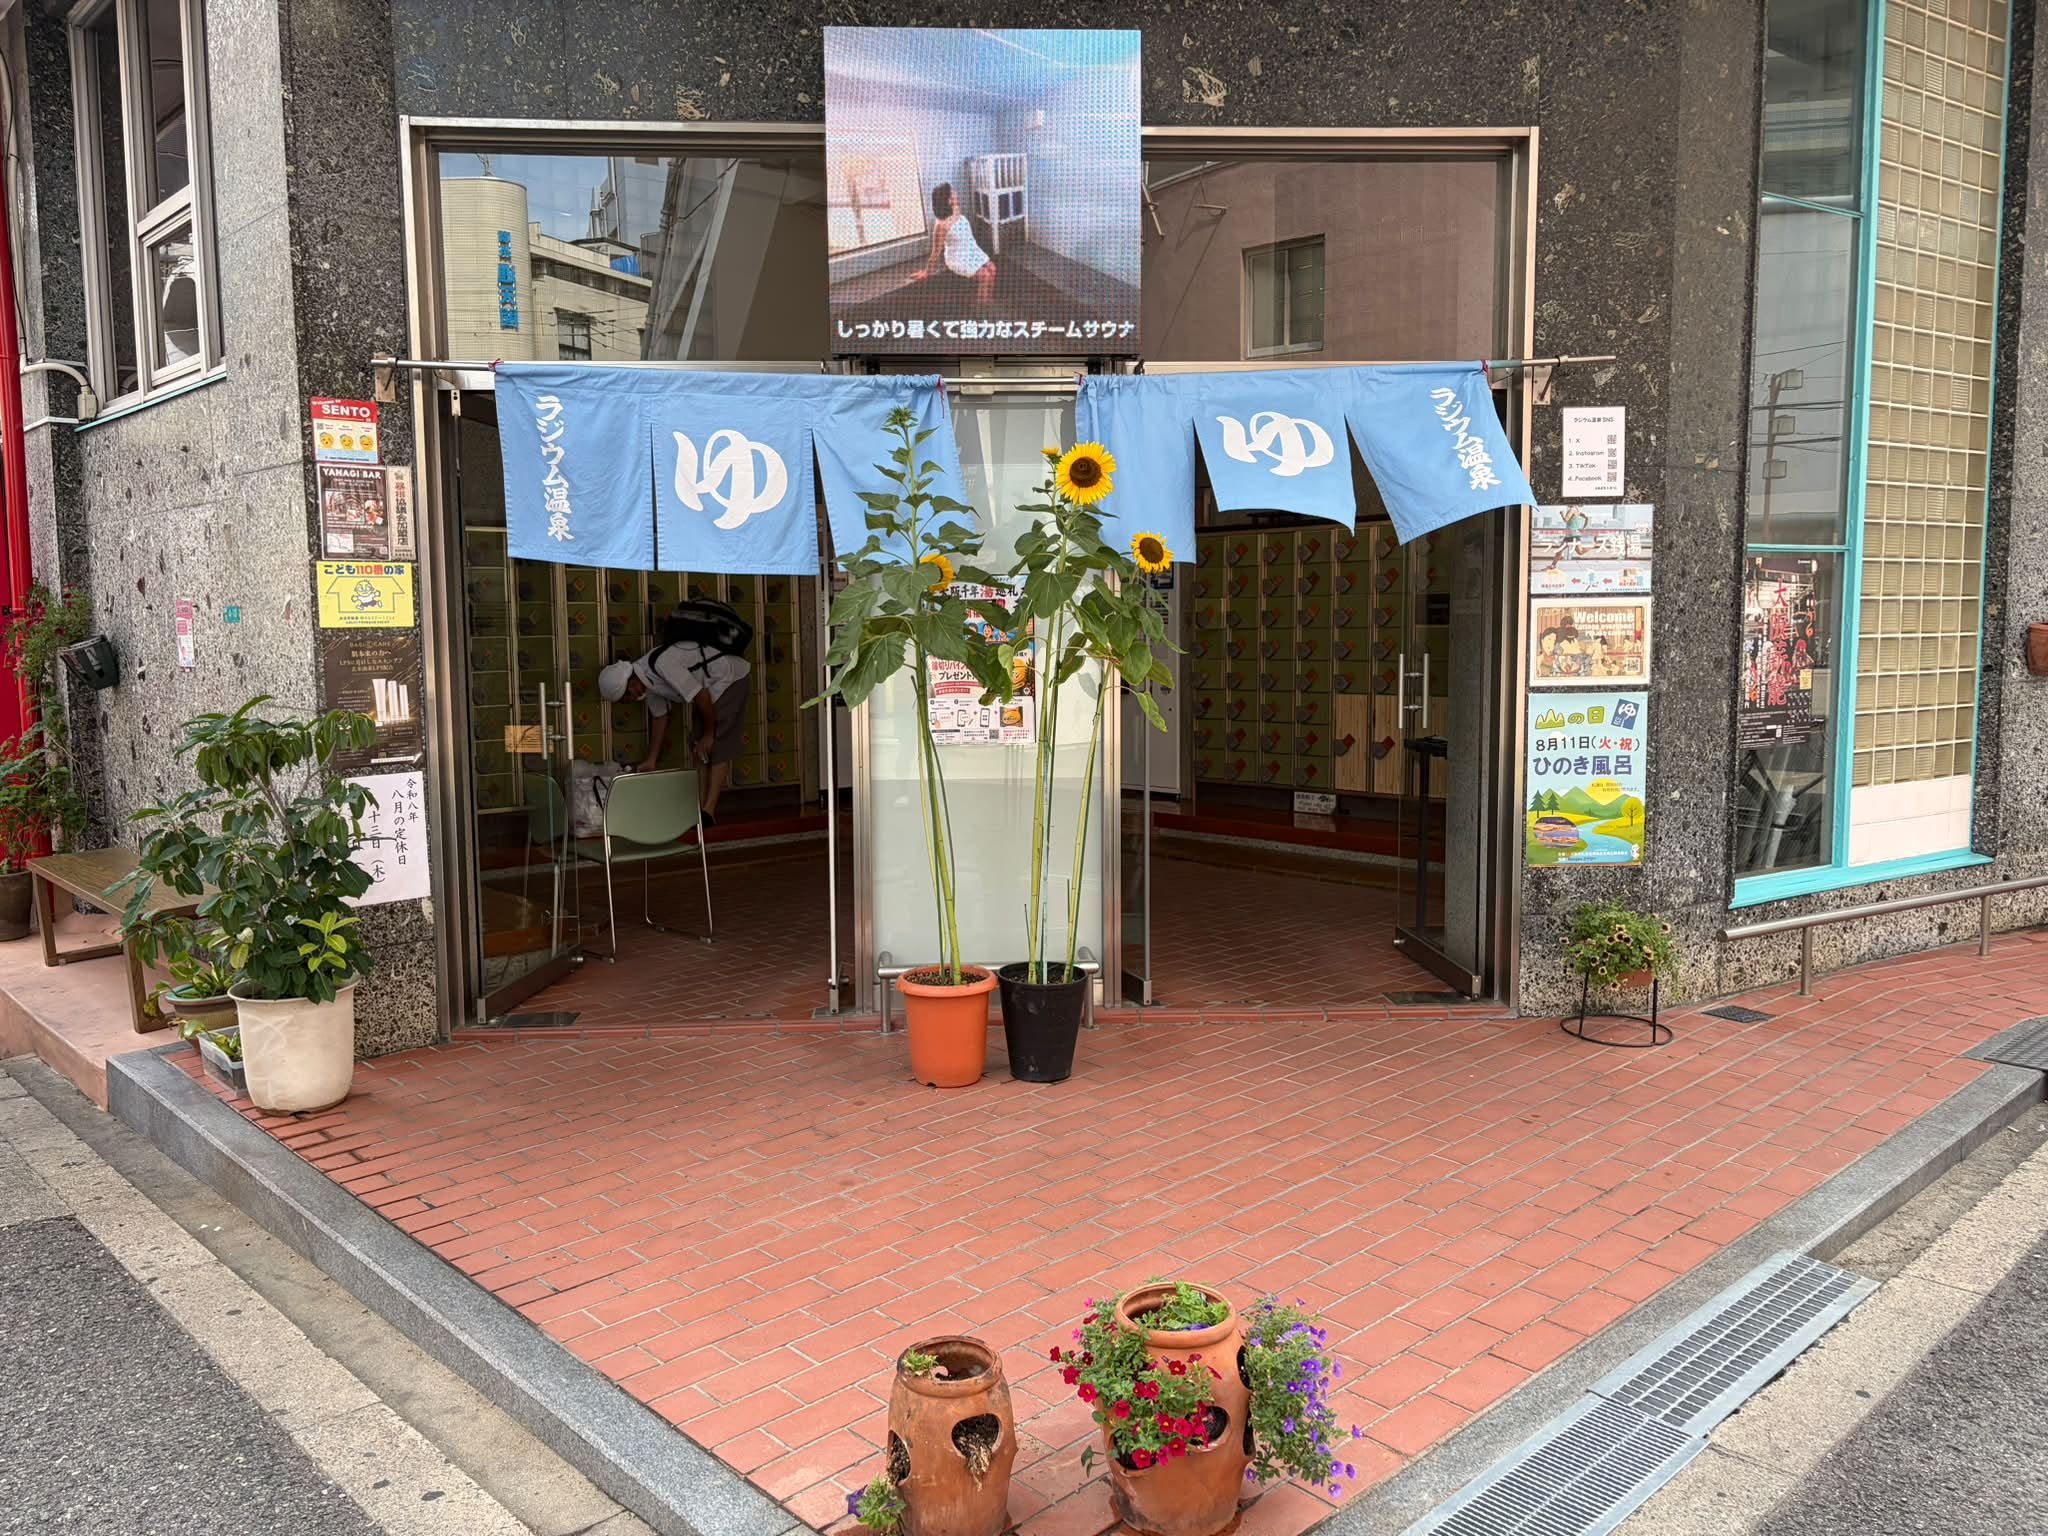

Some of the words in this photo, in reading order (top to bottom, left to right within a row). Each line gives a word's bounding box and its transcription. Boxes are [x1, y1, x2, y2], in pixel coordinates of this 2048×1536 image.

[837, 319, 1135, 340] しっかり暑くて強力なスチームサウナ
[321, 404, 371, 418] SENTO
[1215, 411, 1335, 477] ゆ
[1429, 387, 1502, 491] ラジウム温泉
[322, 467, 361, 478] YANAGI
[362, 470, 382, 479] BAR
[535, 395, 575, 542] ラジウム温泉
[672, 428, 788, 530] ゆ
[323, 564, 405, 575] こども110番の家
[1573, 611, 1635, 624] Welcome
[1535, 705, 1605, 730] 山の日
[1532, 755, 1632, 776] ひのき風呂
[406, 778, 419, 823] 令和八年
[391, 788, 409, 866] 八月の定休日
